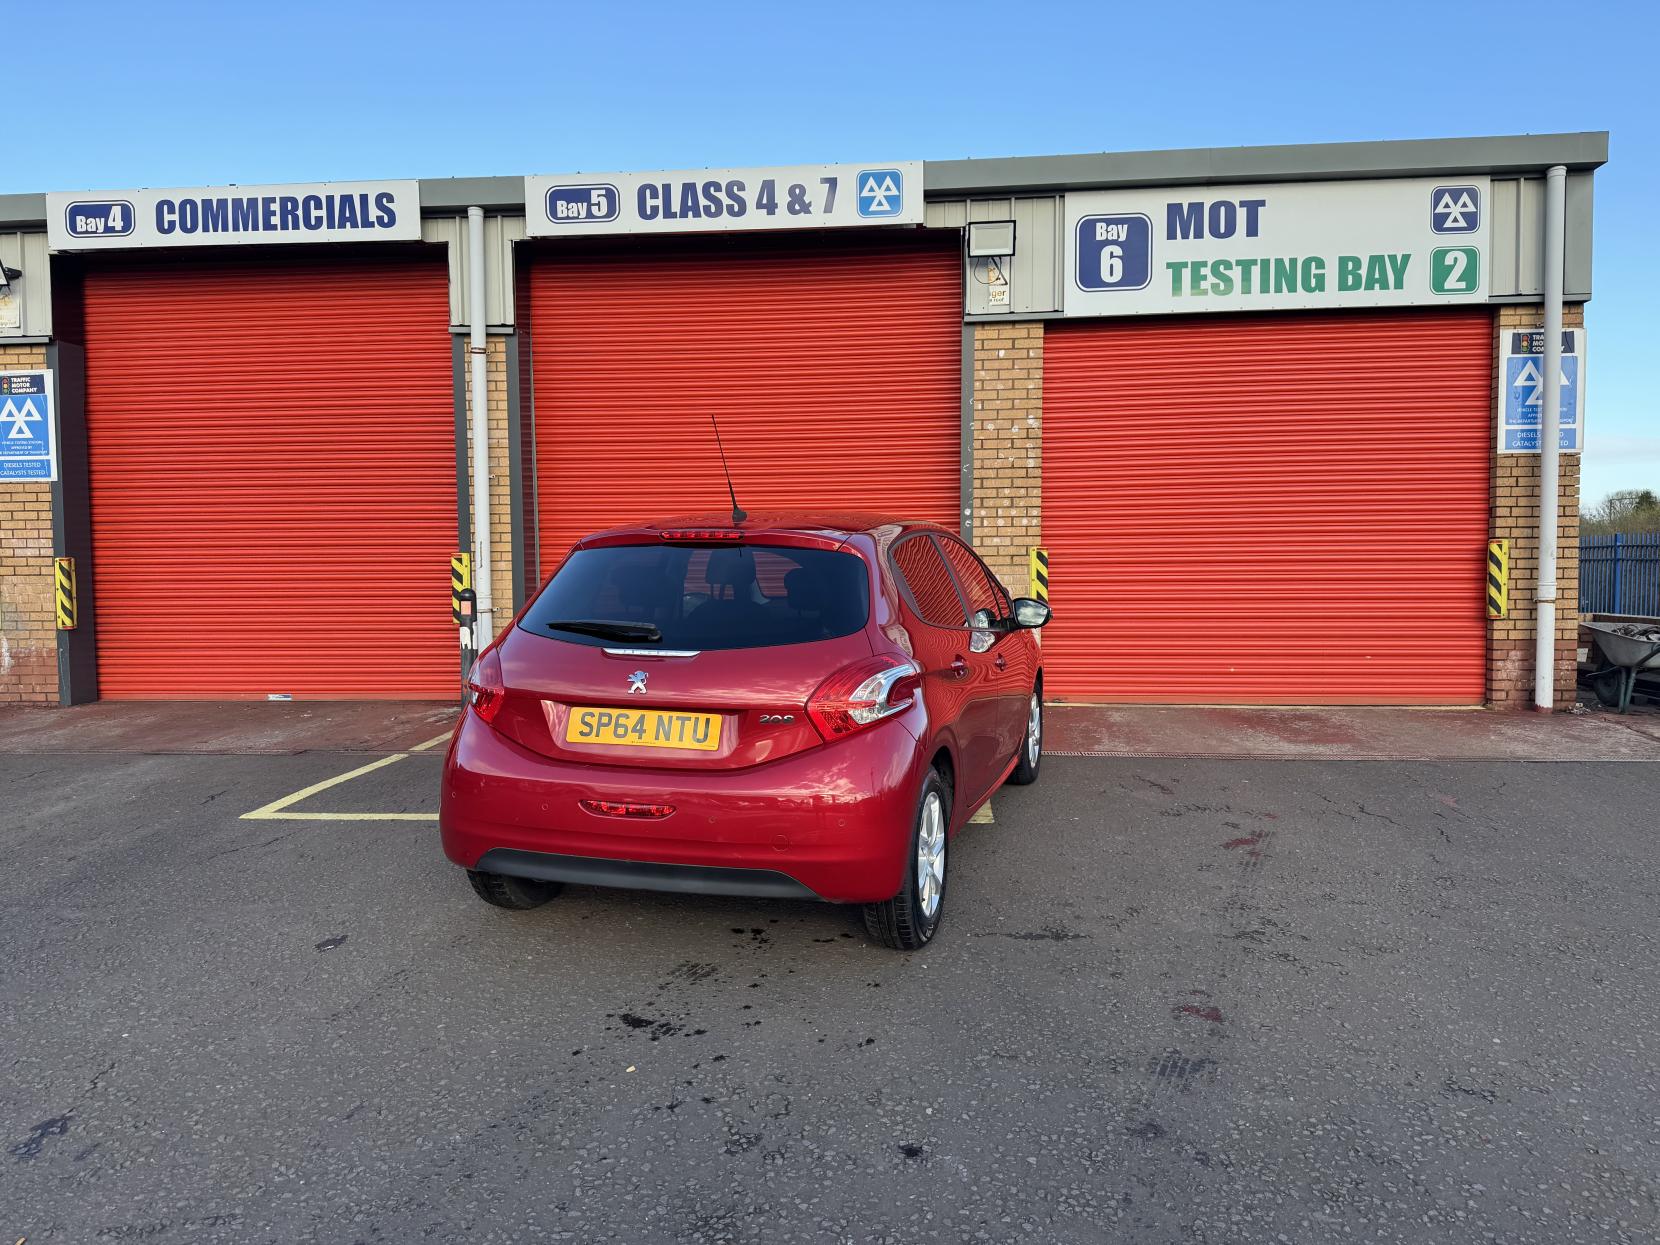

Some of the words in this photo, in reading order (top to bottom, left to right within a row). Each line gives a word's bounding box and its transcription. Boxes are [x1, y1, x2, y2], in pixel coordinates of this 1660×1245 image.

[155, 192, 397, 235] COMMERCIALS
[556, 200, 587, 219] Bay
[590, 189, 608, 217] 5
[637, 179, 747, 221] CLASS
[756, 179, 778, 216] 4
[787, 183, 813, 215] &
[819, 176, 838, 214] 7
[76, 215, 105, 233] Bay
[107, 205, 124, 231] 4
[1095, 222, 1128, 242] Bay
[1166, 199, 1266, 241] MOT
[1100, 244, 1123, 283] 6
[1166, 255, 1326, 298] TESTING
[1337, 253, 1412, 292] BAY
[1443, 250, 1468, 290] 2
[579, 711, 647, 740] SP64
[654, 714, 711, 744] NTU
